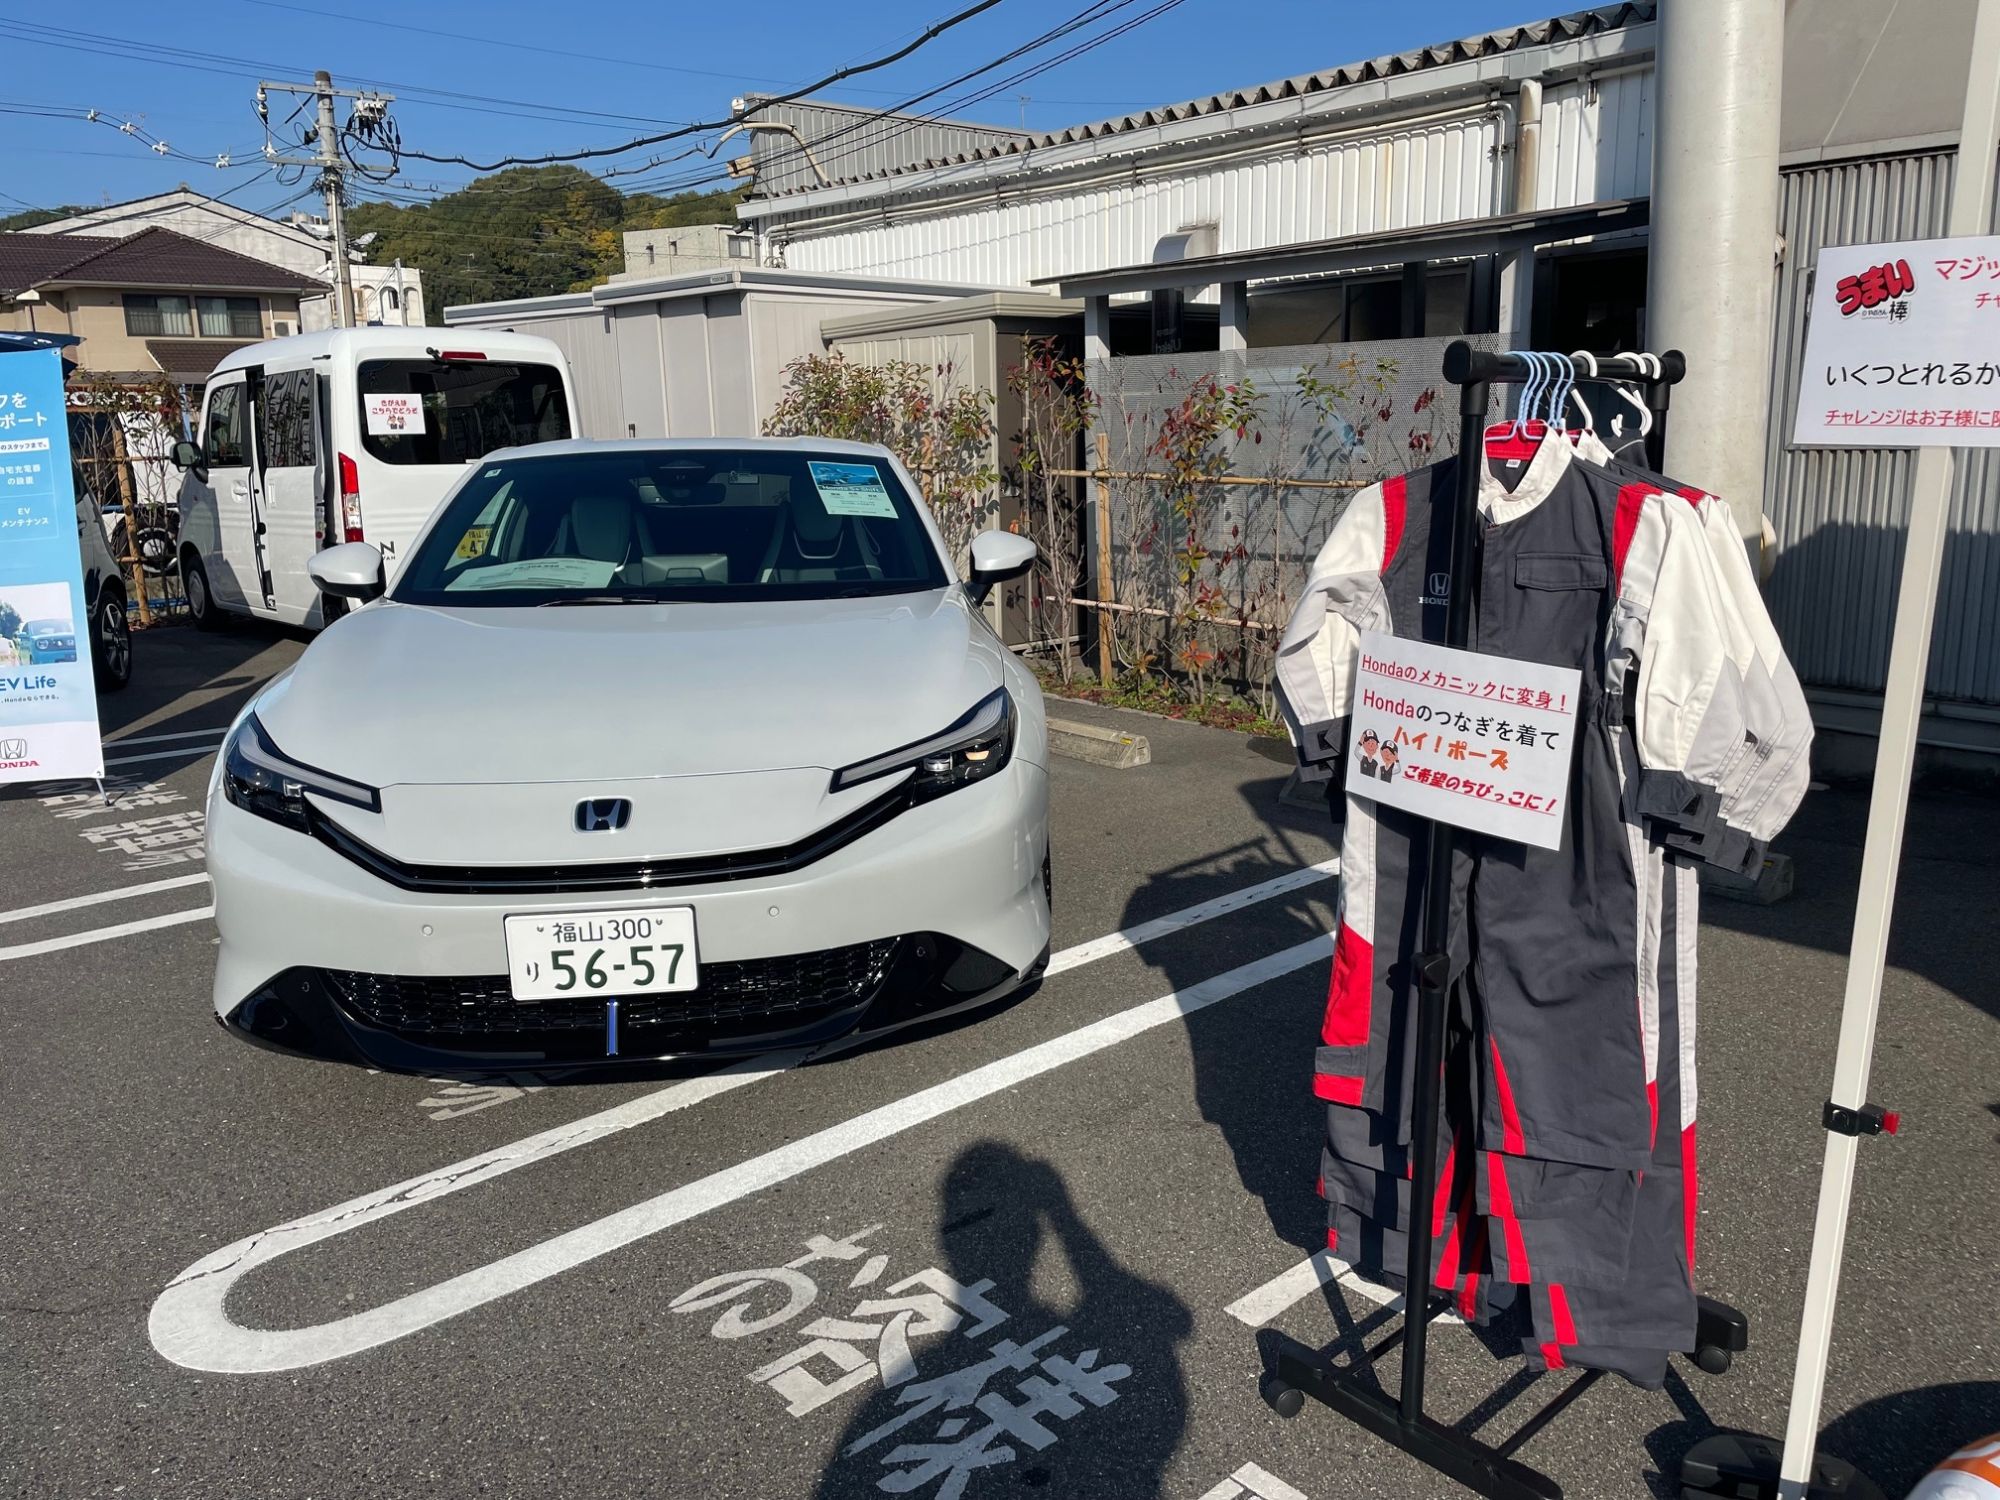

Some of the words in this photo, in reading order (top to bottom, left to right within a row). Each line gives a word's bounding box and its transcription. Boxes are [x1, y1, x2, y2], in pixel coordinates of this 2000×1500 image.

[1836, 259, 1915, 315] うまい
[1889, 301, 1908, 321] 棒
[1826, 362, 2000, 386] いくつとれるか
[2, 517, 49, 528] メンテナンス
[17, 507, 31, 515] EV
[24, 676, 57, 690] Life
[1361, 654, 1568, 711] Hondaのメカニックに変身！
[1363, 688, 1561, 750] Hondaのつなぎを着て
[1393, 726, 1510, 771] ハイ！ポーズ
[1402, 764, 1559, 813] ご希望のちびっこに！
[526, 962, 540, 983] り
[550, 944, 685, 991] 56-57
